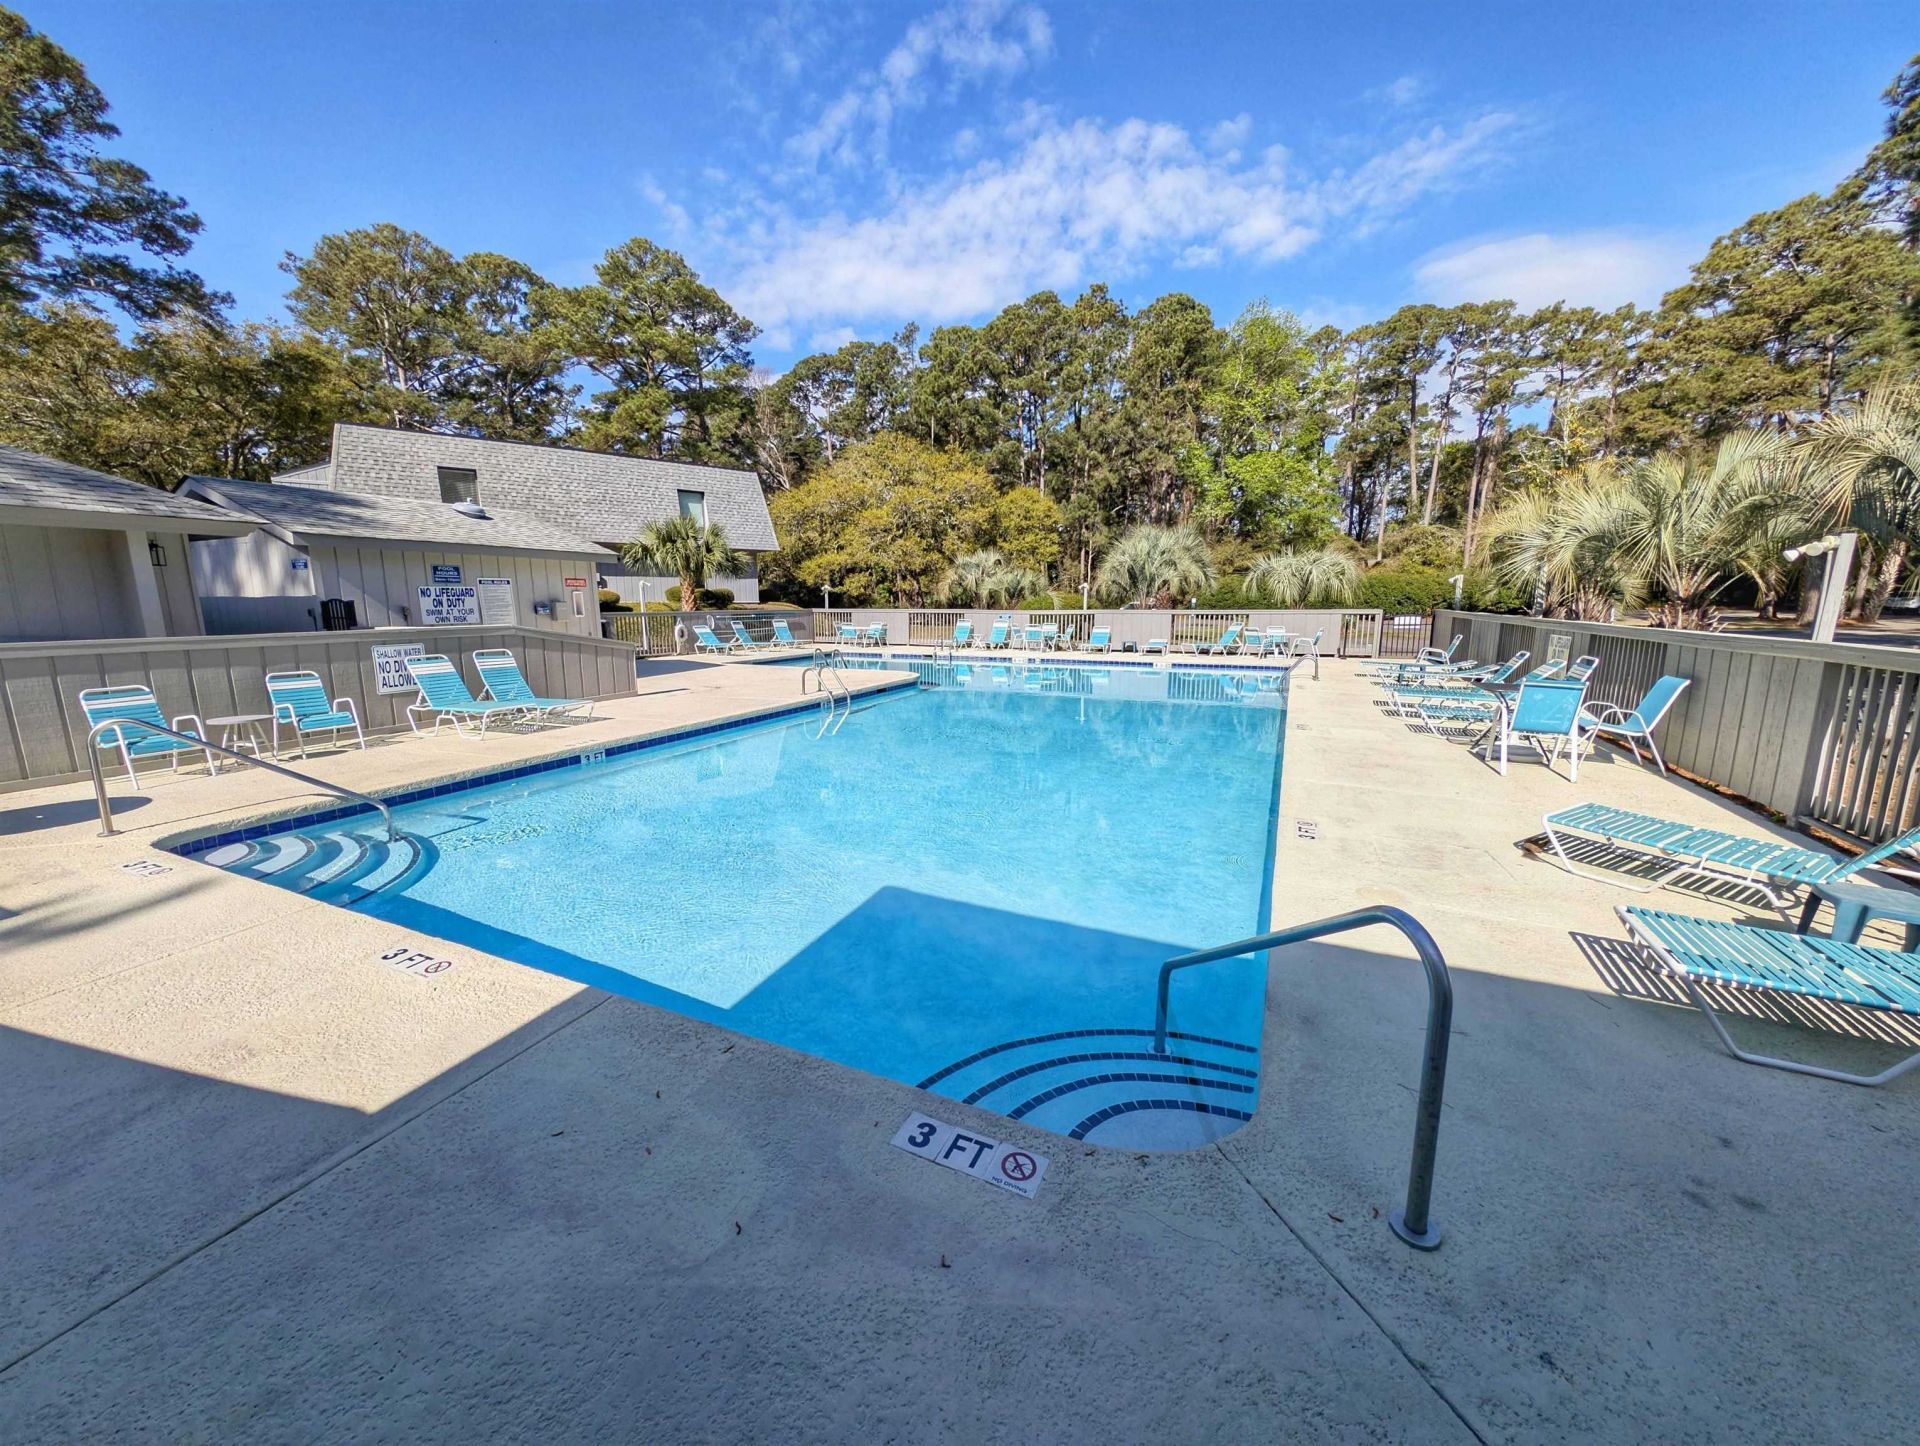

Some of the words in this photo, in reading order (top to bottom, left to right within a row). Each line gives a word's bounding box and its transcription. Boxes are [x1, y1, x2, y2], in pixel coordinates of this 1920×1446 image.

[420, 587, 431, 598] NO
[434, 587, 475, 598] LIFEGUARD
[432, 599, 443, 608] ON
[447, 598, 465, 608] DUTY
[446, 608, 454, 616] AT
[457, 608, 475, 616] YOUR
[376, 649, 402, 659] SHALLOW
[403, 647, 421, 657] WATER
[378, 660, 391, 674] NO
[393, 660, 408, 673] DIV
[382, 673, 418, 688] ALLOWE
[381, 948, 409, 960] 3
[395, 953, 435, 969] FT
[907, 1122, 937, 1148] 3
[943, 1133, 994, 1169] FT
[991, 1176, 1003, 1184] NO
[1003, 1180, 1028, 1194] DIVING
